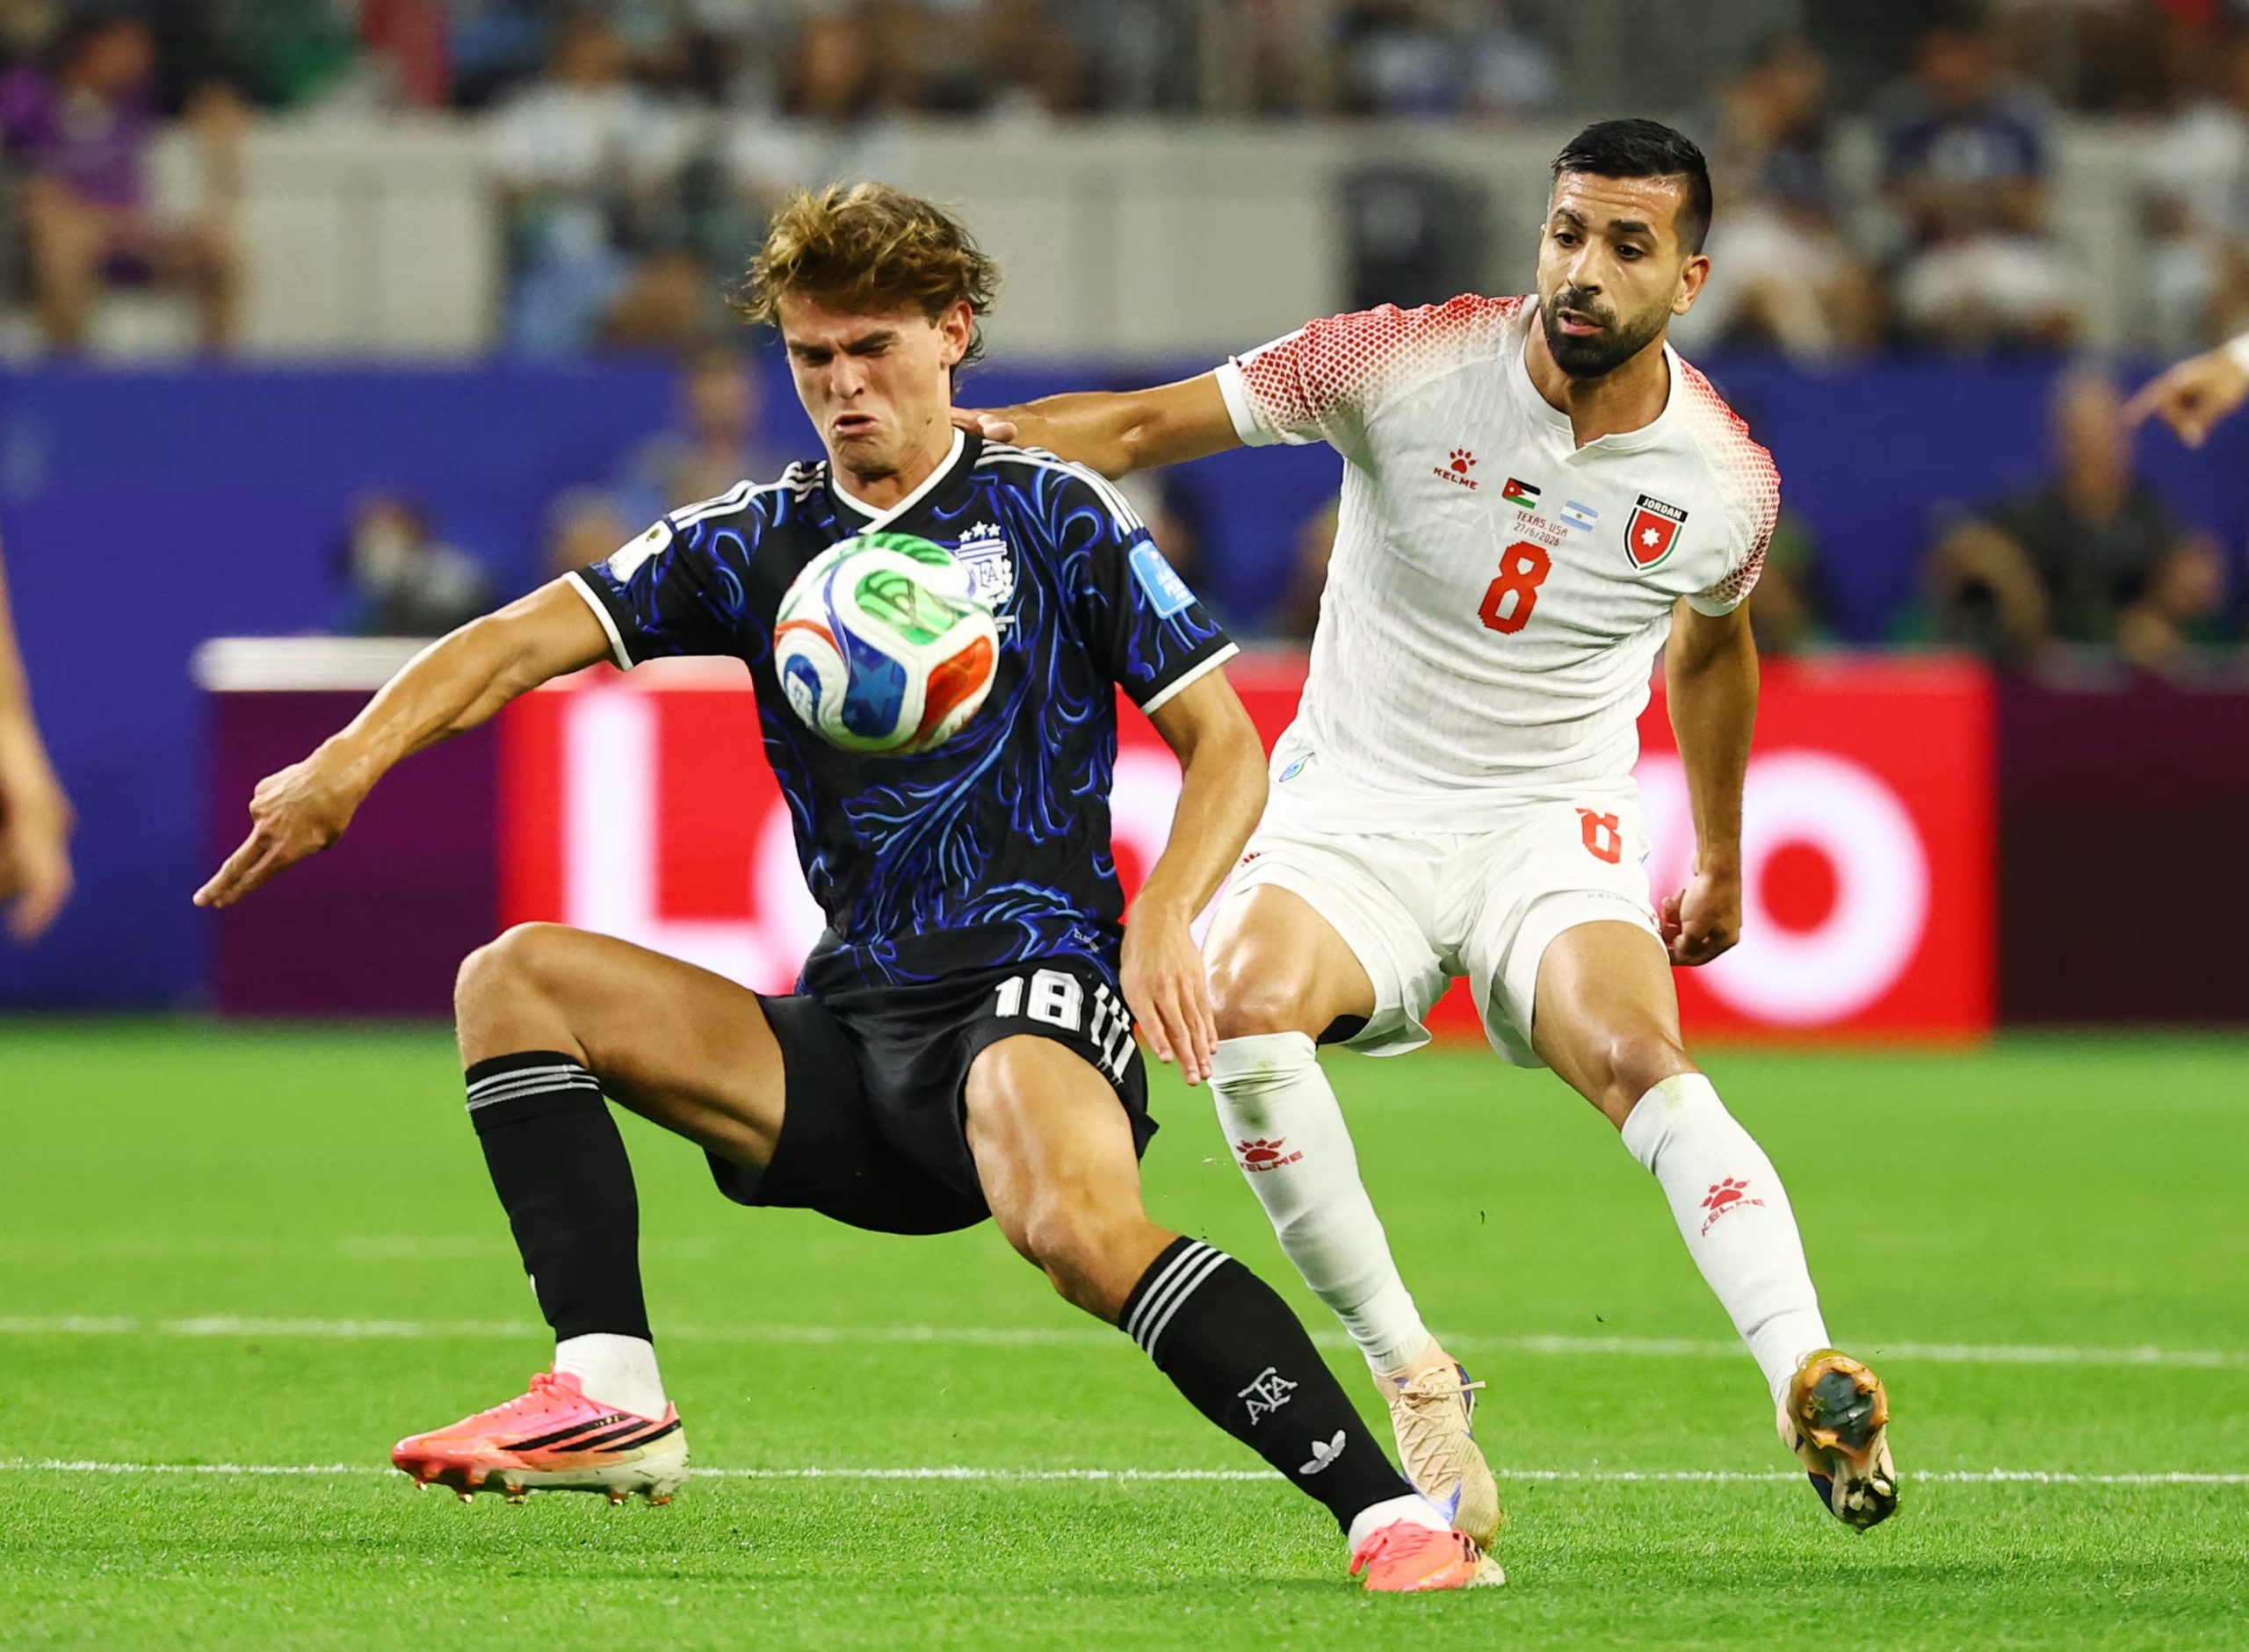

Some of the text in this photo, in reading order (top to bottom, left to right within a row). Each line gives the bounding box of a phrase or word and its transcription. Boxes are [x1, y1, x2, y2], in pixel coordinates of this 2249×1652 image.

[1433, 467, 1478, 490] KELME
[1641, 497, 1682, 520] JORDAN
[1513, 522, 1560, 547] 27/6/2026
[1549, 522, 1568, 537] USA
[1478, 540, 1552, 636] 8
[994, 967, 1085, 1033] 18
[1239, 1150, 1304, 1172] KELME
